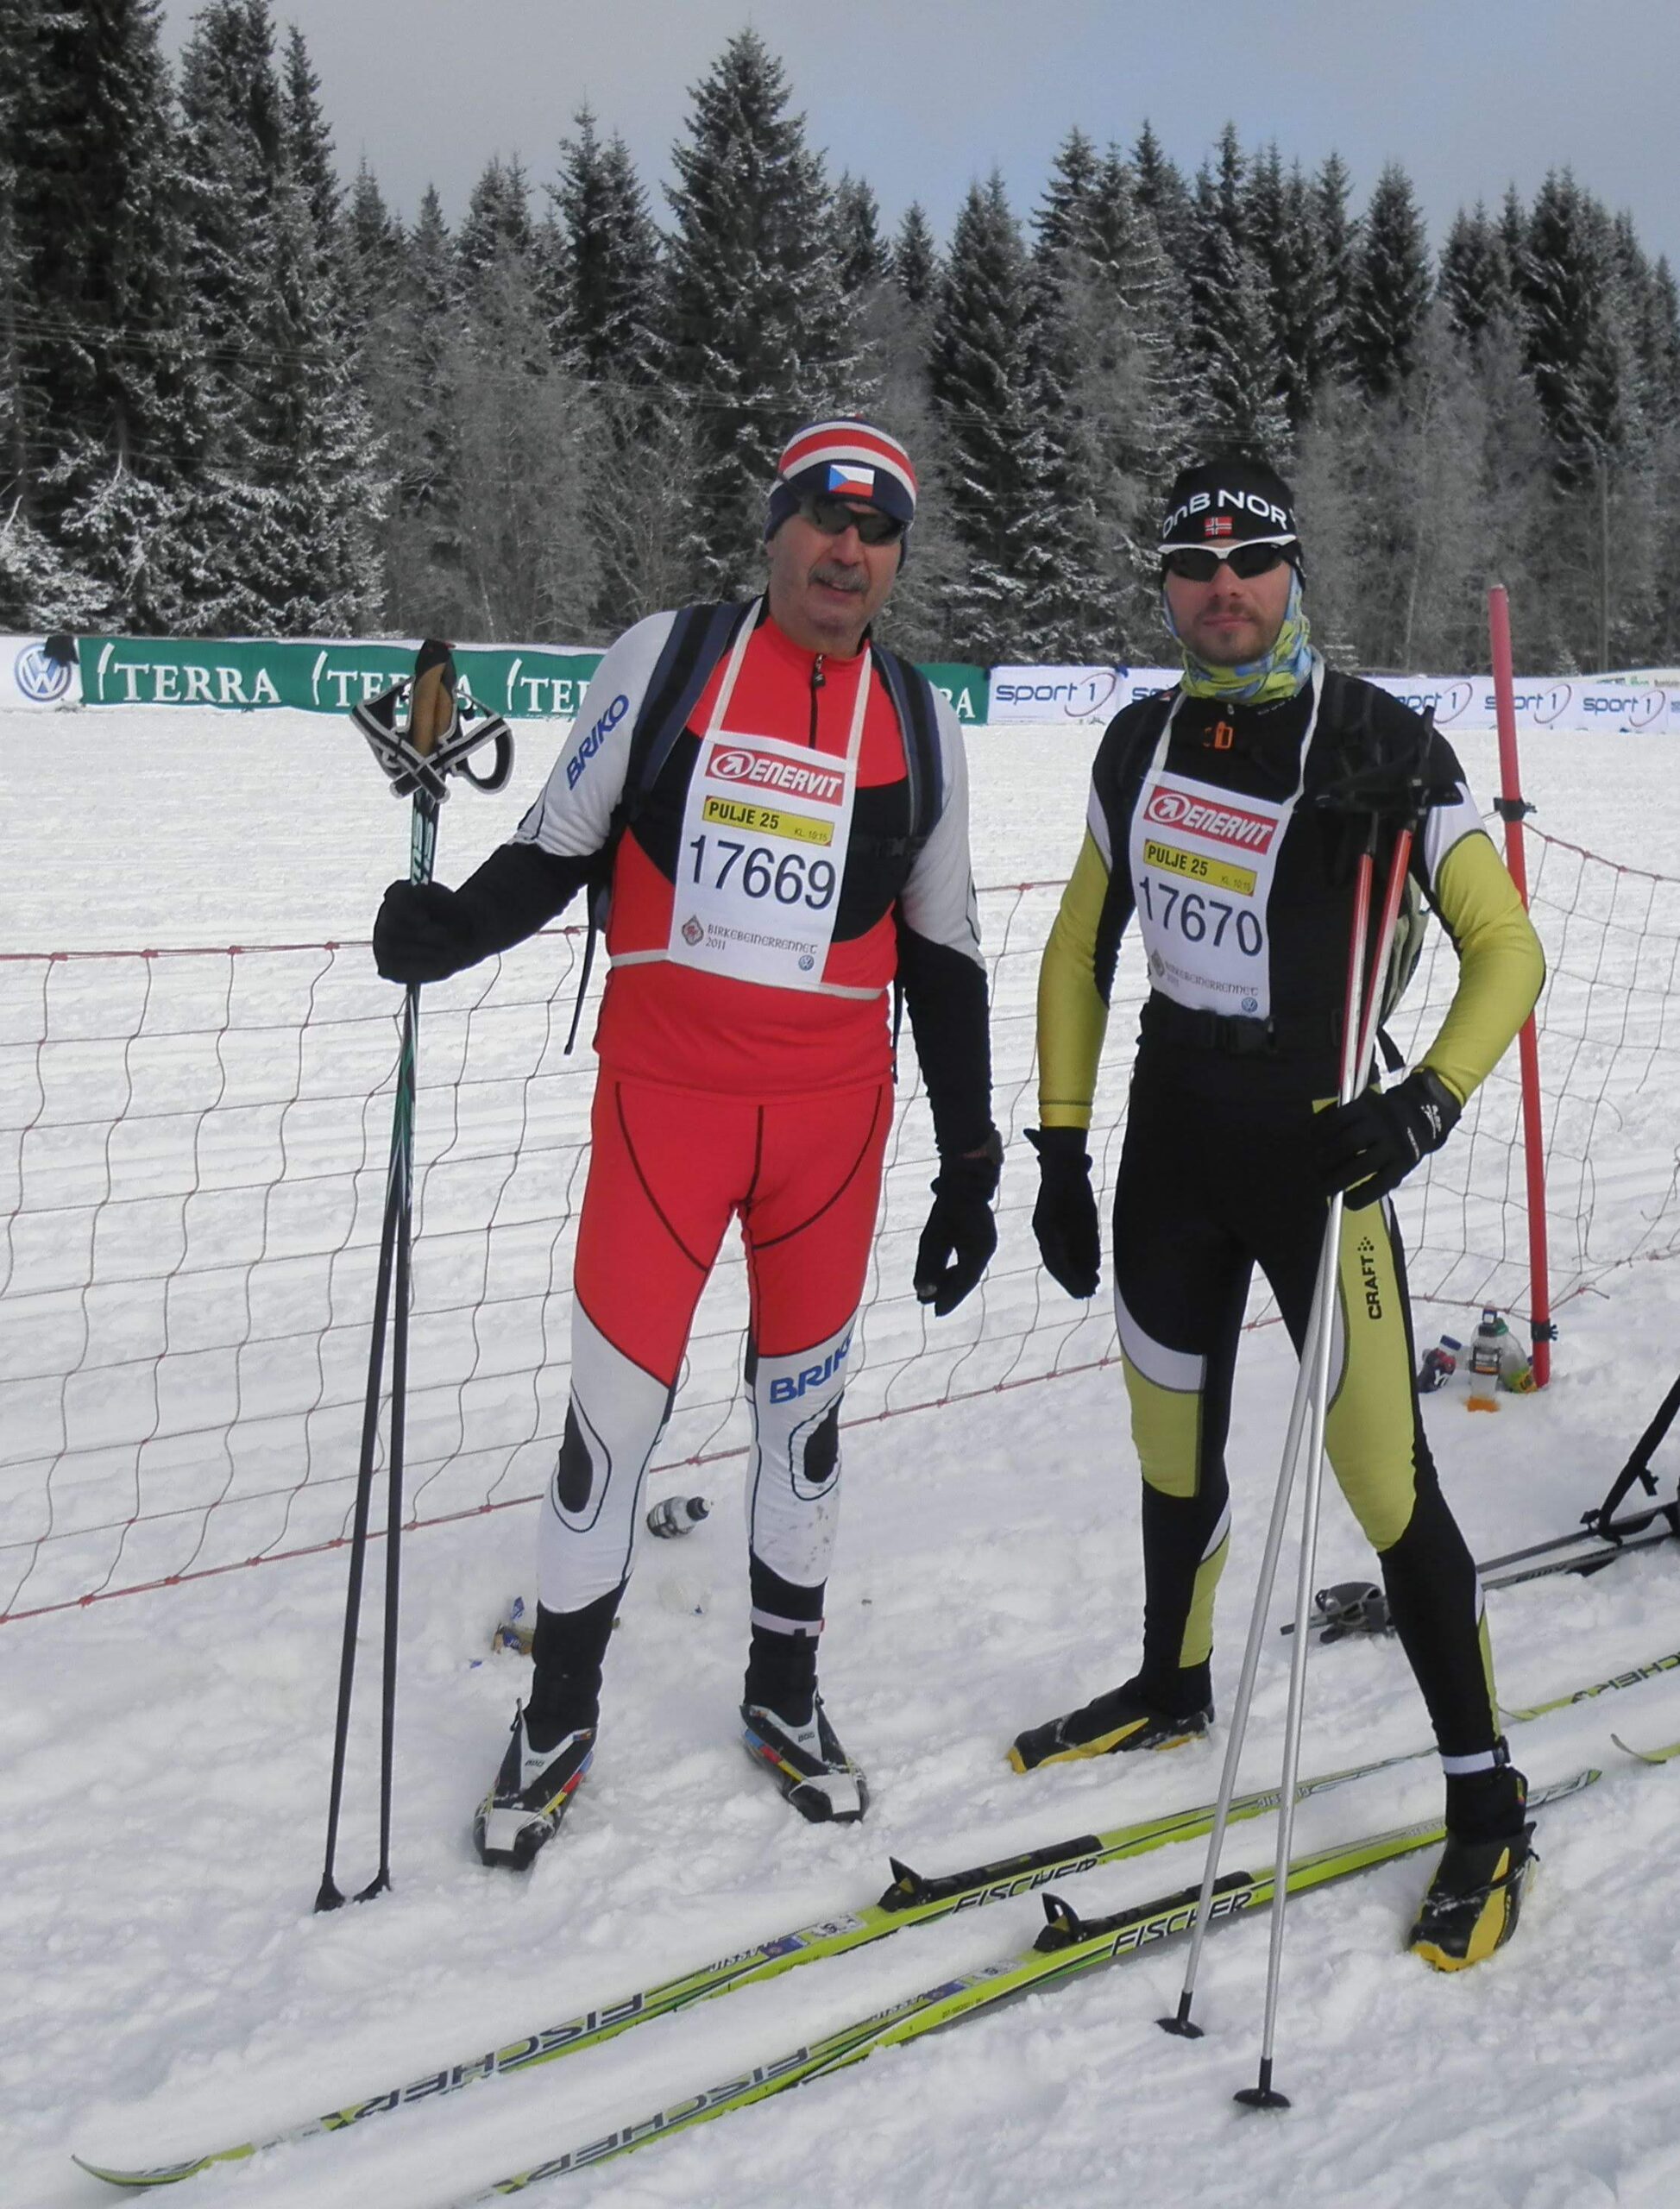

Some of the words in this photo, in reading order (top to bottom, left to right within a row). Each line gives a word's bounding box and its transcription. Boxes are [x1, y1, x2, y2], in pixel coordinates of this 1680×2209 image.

[113, 663, 282, 704] TERRA
[327, 669, 478, 710] TEA
[996, 683, 1078, 705] sport
[1484, 693, 1543, 710] sort
[1582, 696, 1639, 715] sport
[566, 694, 630, 790] BRIKO
[749, 758, 842, 799] ENERVIT
[708, 801, 756, 826] PULJE
[759, 812, 780, 830] 25
[1182, 805, 1274, 846] ENERVIT
[689, 834, 837, 911] 17669
[1148, 845, 1188, 870] PULJE
[1191, 858, 1209, 878] 25
[1139, 876, 1263, 957] 17670
[705, 937, 727, 951] 2011
[1360, 1255, 1382, 1320] CRAFT
[354, 1992, 643, 2119] FISCHER
[527, 2046, 809, 2181] FISCHER
